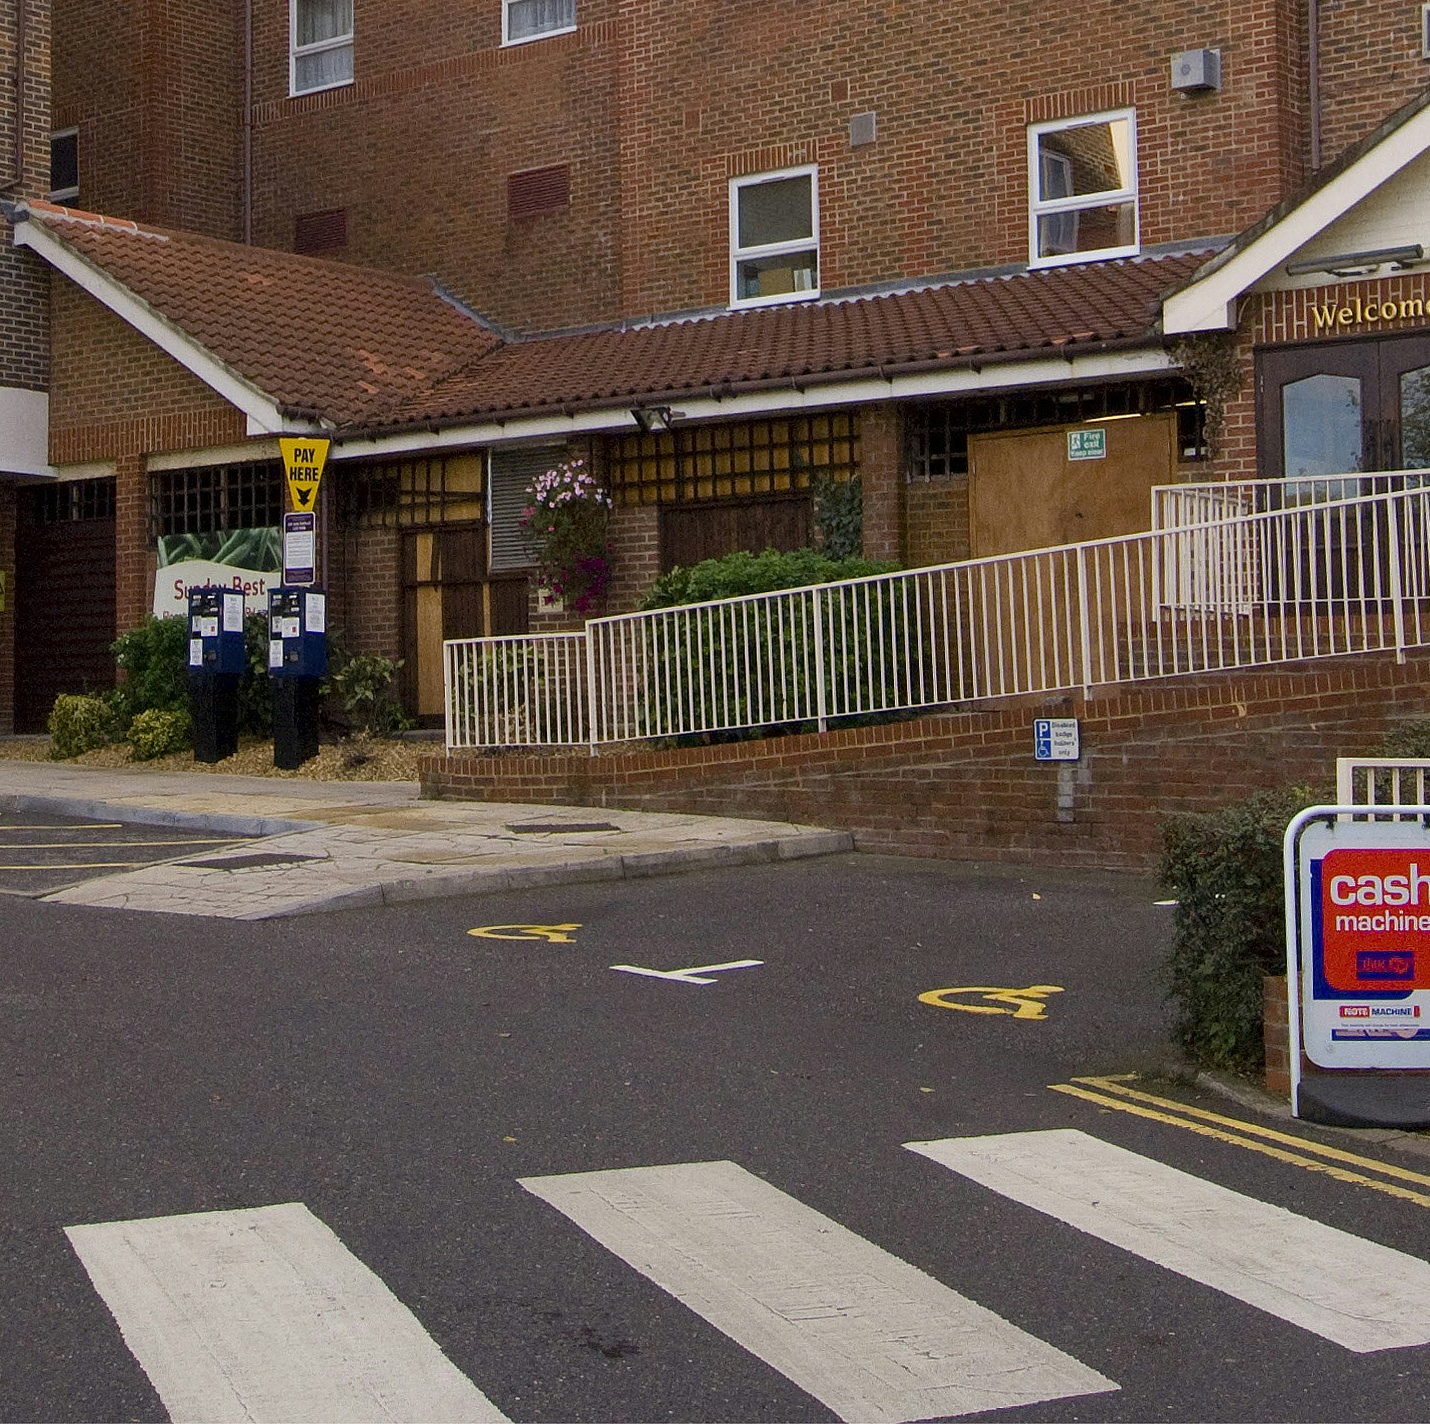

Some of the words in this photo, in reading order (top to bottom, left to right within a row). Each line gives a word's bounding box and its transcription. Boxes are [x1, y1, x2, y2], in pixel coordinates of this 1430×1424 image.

[294, 448, 315, 463] PAY
[290, 467, 319, 481] HERE
[232, 576, 265, 596] Best
